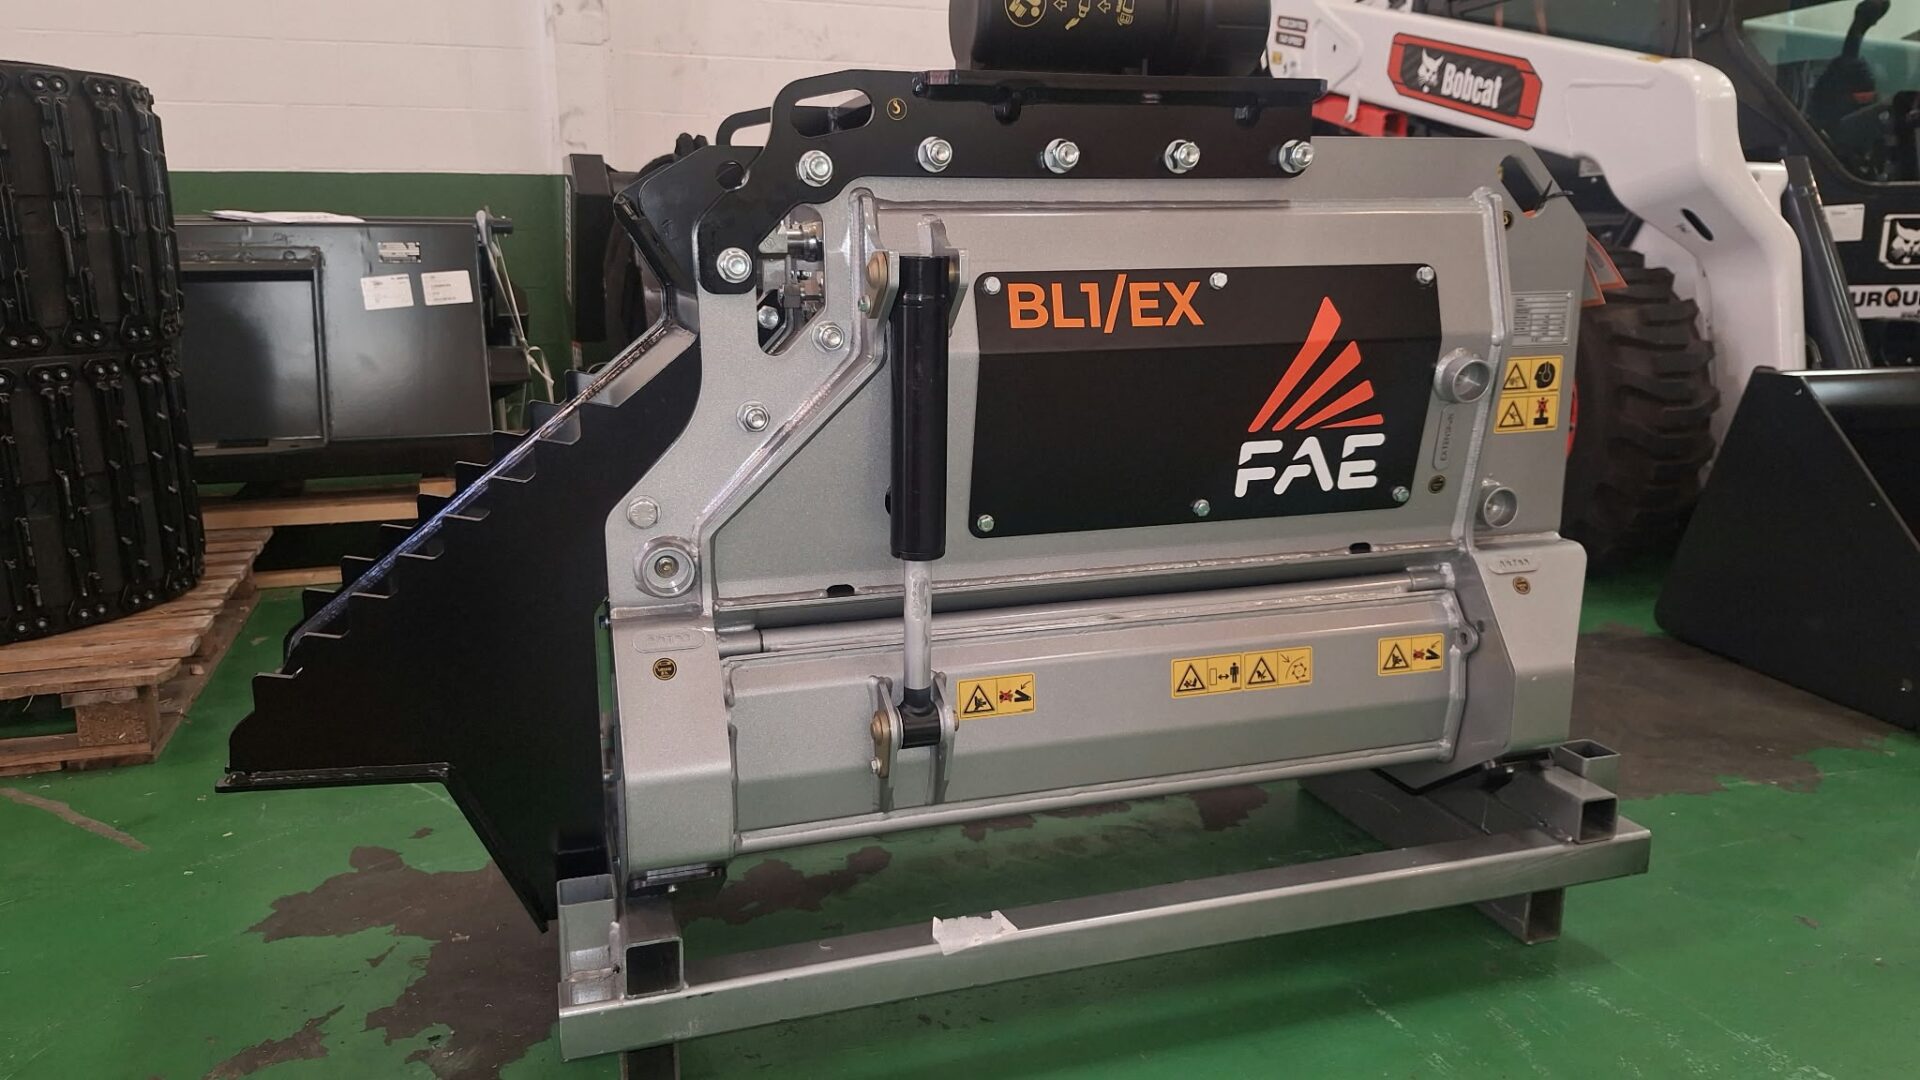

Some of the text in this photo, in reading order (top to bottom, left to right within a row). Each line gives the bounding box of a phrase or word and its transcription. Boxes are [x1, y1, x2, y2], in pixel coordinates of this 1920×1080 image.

[1440, 62, 1503, 109] Bobcat
[1007, 273, 1205, 334] BL1/EX
[1850, 287, 1920, 308] URQU
[1234, 432, 1386, 498] FAE
